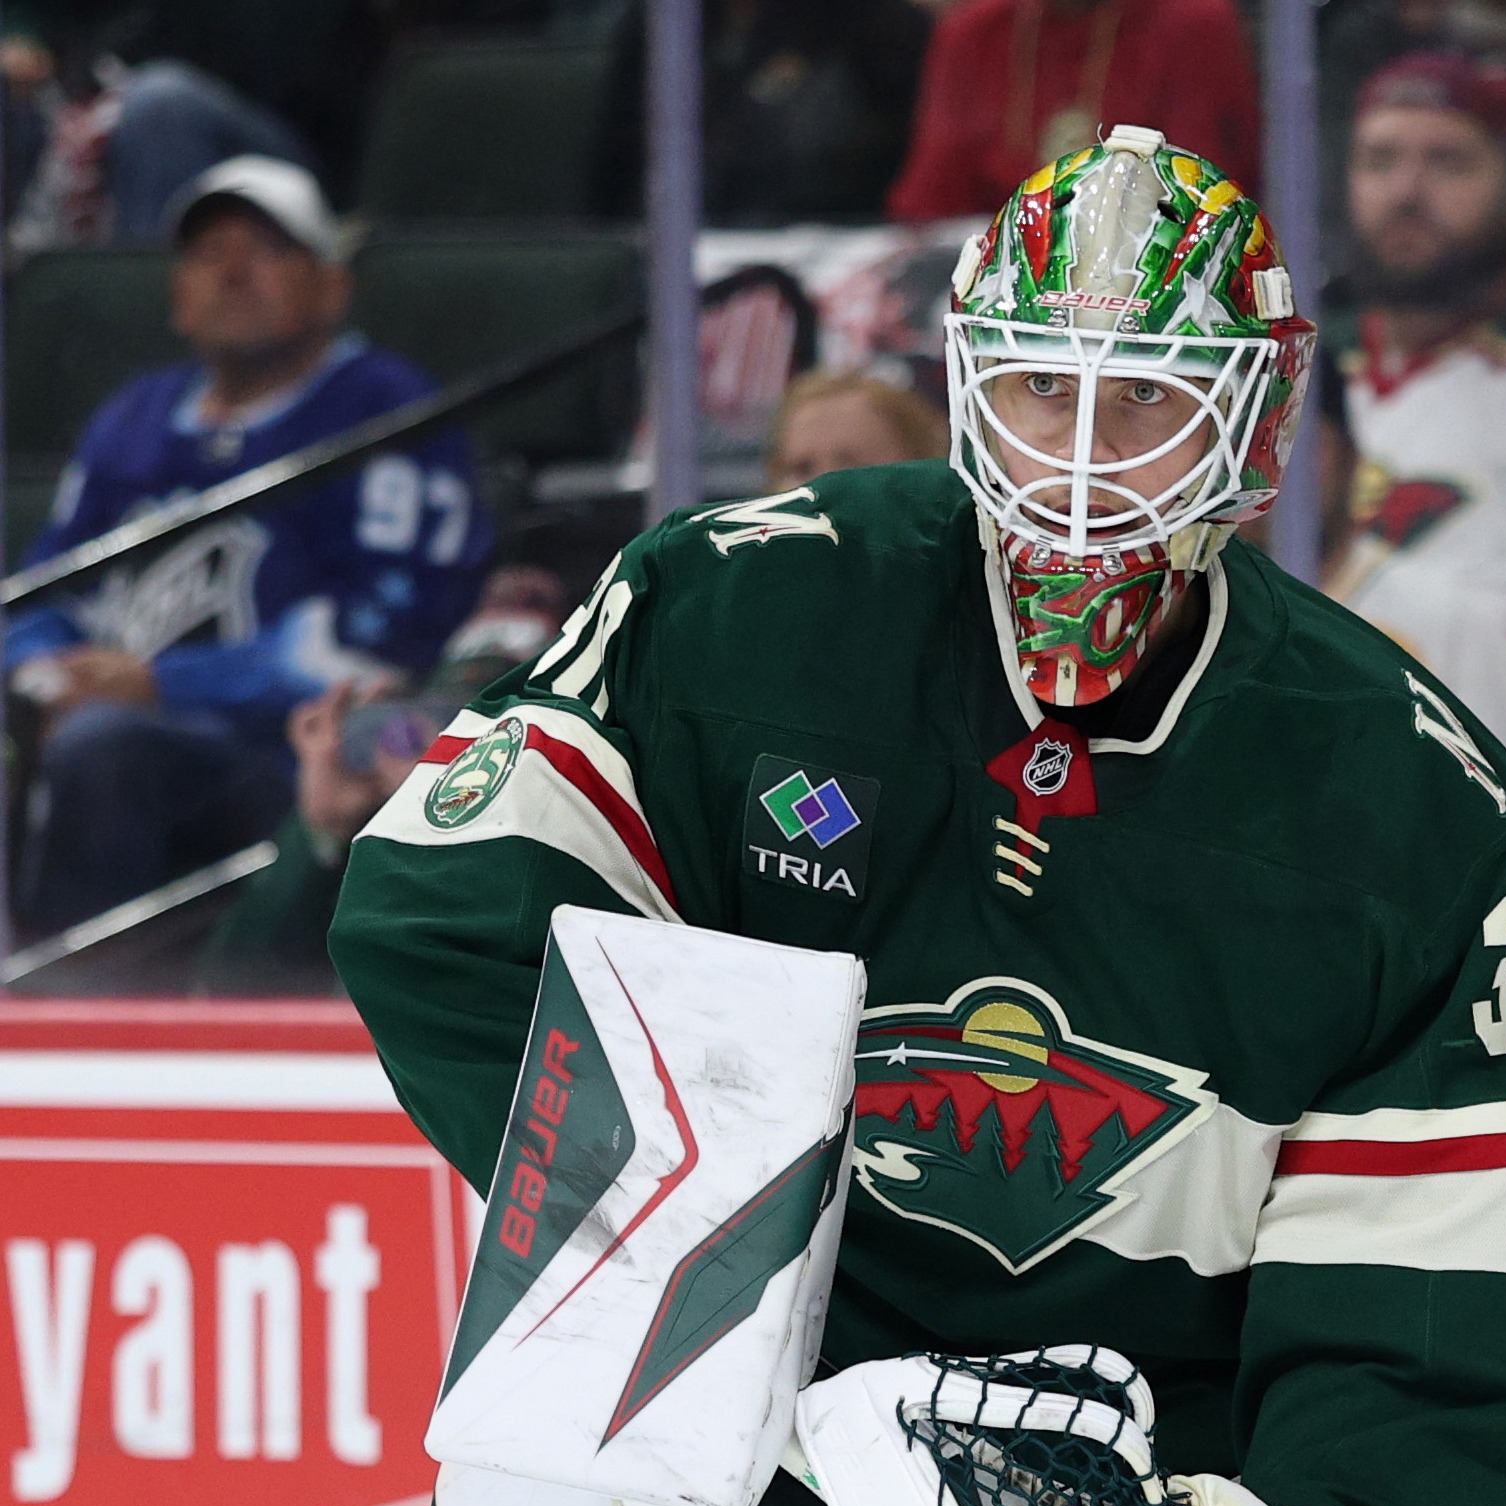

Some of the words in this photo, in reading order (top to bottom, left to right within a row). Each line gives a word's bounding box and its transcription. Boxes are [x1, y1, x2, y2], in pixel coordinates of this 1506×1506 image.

[1039, 290, 1151, 317] BAUER
[1031, 757, 1064, 781] NHL
[749, 844, 857, 897] TRIA
[499, 1028, 580, 1259] BAUER
[5, 1203, 382, 1502] yant
